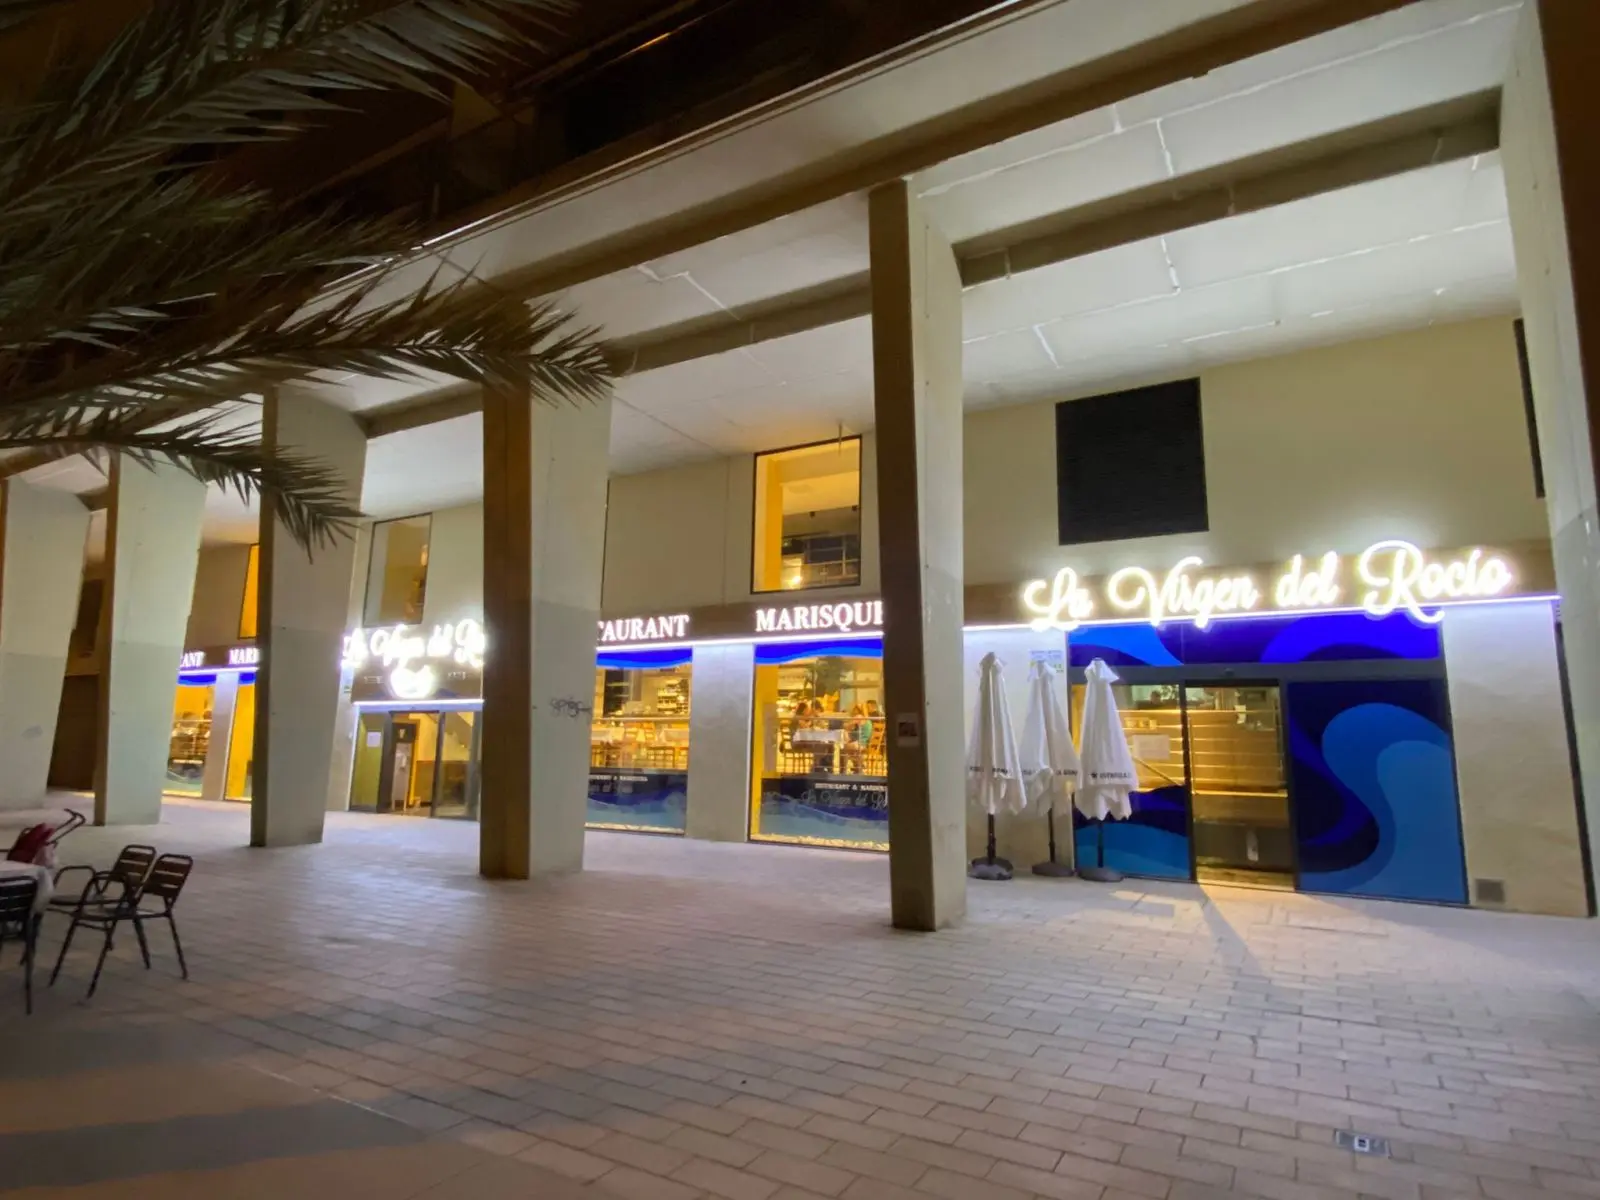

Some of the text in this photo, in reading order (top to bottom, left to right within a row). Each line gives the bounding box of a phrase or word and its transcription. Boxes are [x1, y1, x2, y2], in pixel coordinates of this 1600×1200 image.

[1023, 566, 1094, 632] La
[1107, 555, 1260, 629] Virgen
[1275, 550, 1341, 608] del
[180, 650, 206, 668] ANT
